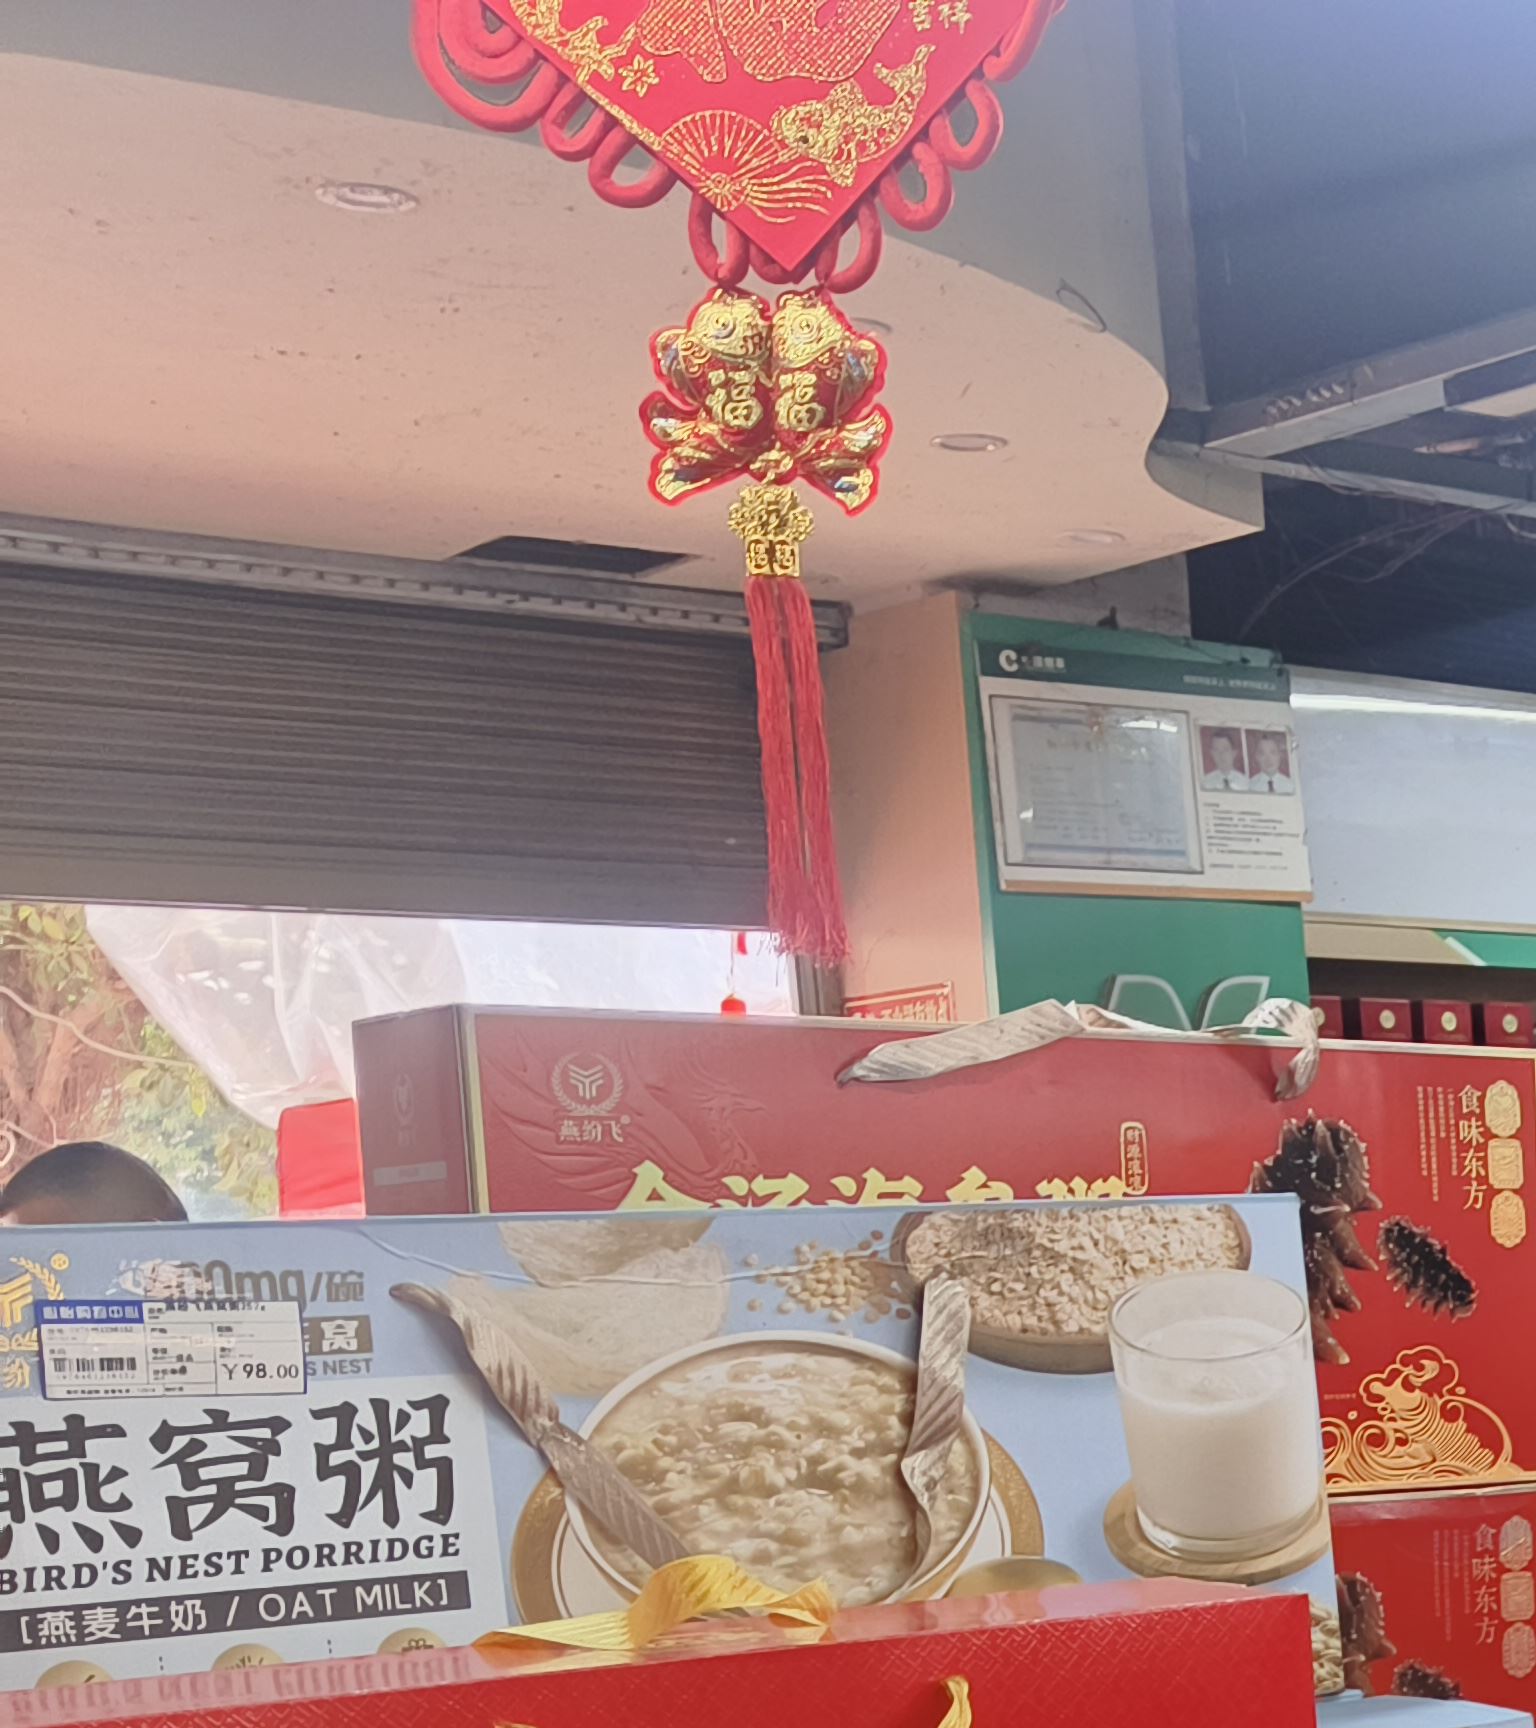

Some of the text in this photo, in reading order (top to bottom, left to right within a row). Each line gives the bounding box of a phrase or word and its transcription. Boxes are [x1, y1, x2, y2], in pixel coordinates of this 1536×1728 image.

[706, 368, 763, 430] 福
[775, 371, 826, 432] 福
[1458, 1085, 1487, 1210] 食味东方
[0, 1393, 458, 1562] 燕窝粥
[0, 1533, 461, 1595] BIRD'S NEST PORRIDGE
[1472, 1524, 1499, 1645] 食味东方
[258, 1588, 339, 1623] OAT
